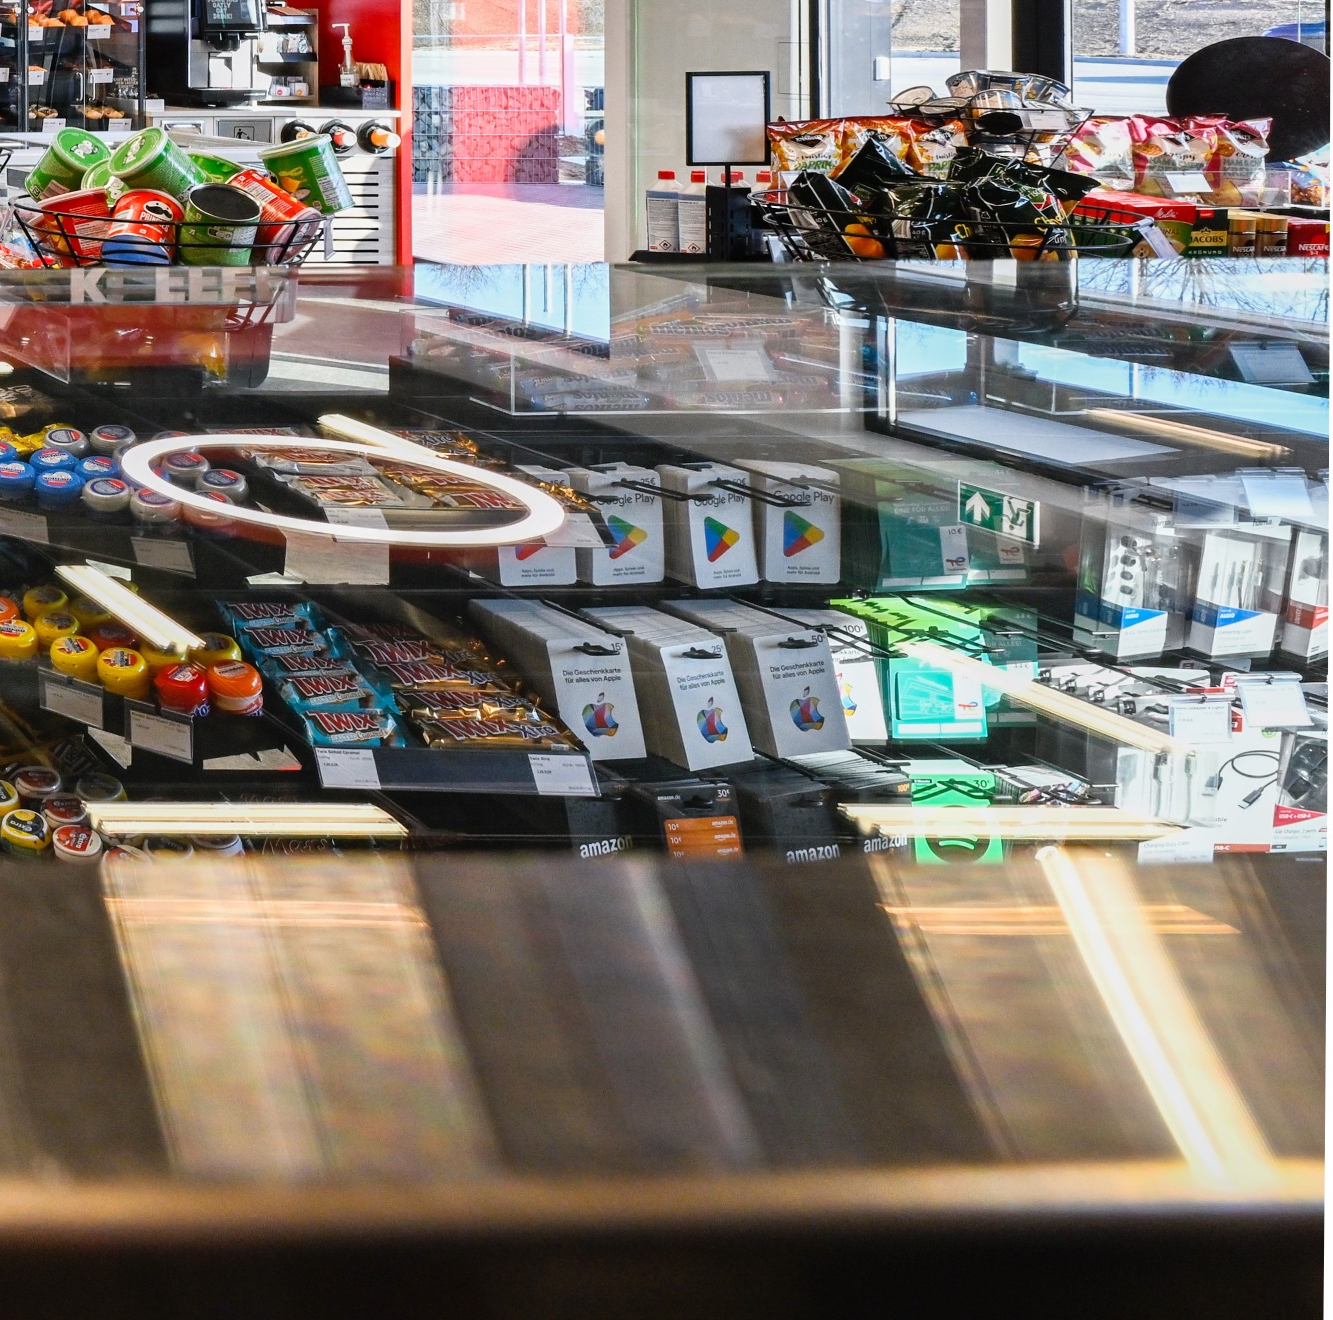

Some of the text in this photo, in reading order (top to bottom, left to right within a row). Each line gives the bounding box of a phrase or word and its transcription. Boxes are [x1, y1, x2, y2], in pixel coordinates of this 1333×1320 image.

[1189, 235, 1224, 244] JACOBS
[634, 493, 656, 506] Play
[727, 493, 746, 505] Play
[812, 491, 834, 505] Play
[230, 602, 296, 621] TWIX
[245, 626, 315, 647] TWIX
[811, 633, 825, 643] 50€
[354, 639, 437, 665] TWIX
[610, 641, 624, 652] 15€
[271, 653, 340, 673] TWIX
[769, 659, 825, 673] Die Geschenkkarte
[377, 661, 462, 686] TWIX
[562, 667, 622, 677] Die Geschenkkarte
[676, 670, 725, 684] Die Geschenkkarte
[772, 672, 781, 680] für
[781, 671, 796, 679] alles
[807, 667, 825, 676] Apple
[575, 676, 590, 684] alles
[603, 675, 622, 683] Apple
[679, 683, 688, 691] für
[710, 678, 726, 686] Apple
[287, 674, 359, 700] TWIX
[407, 690, 491, 710] TWIX
[306, 710, 382, 735] TWIX
[432, 720, 560, 740] TWIX Xtra
[716, 789, 730, 798] 30€
[579, 835, 633, 859] amazon
[863, 834, 908, 853] amazon
[786, 843, 840, 865] amazon
